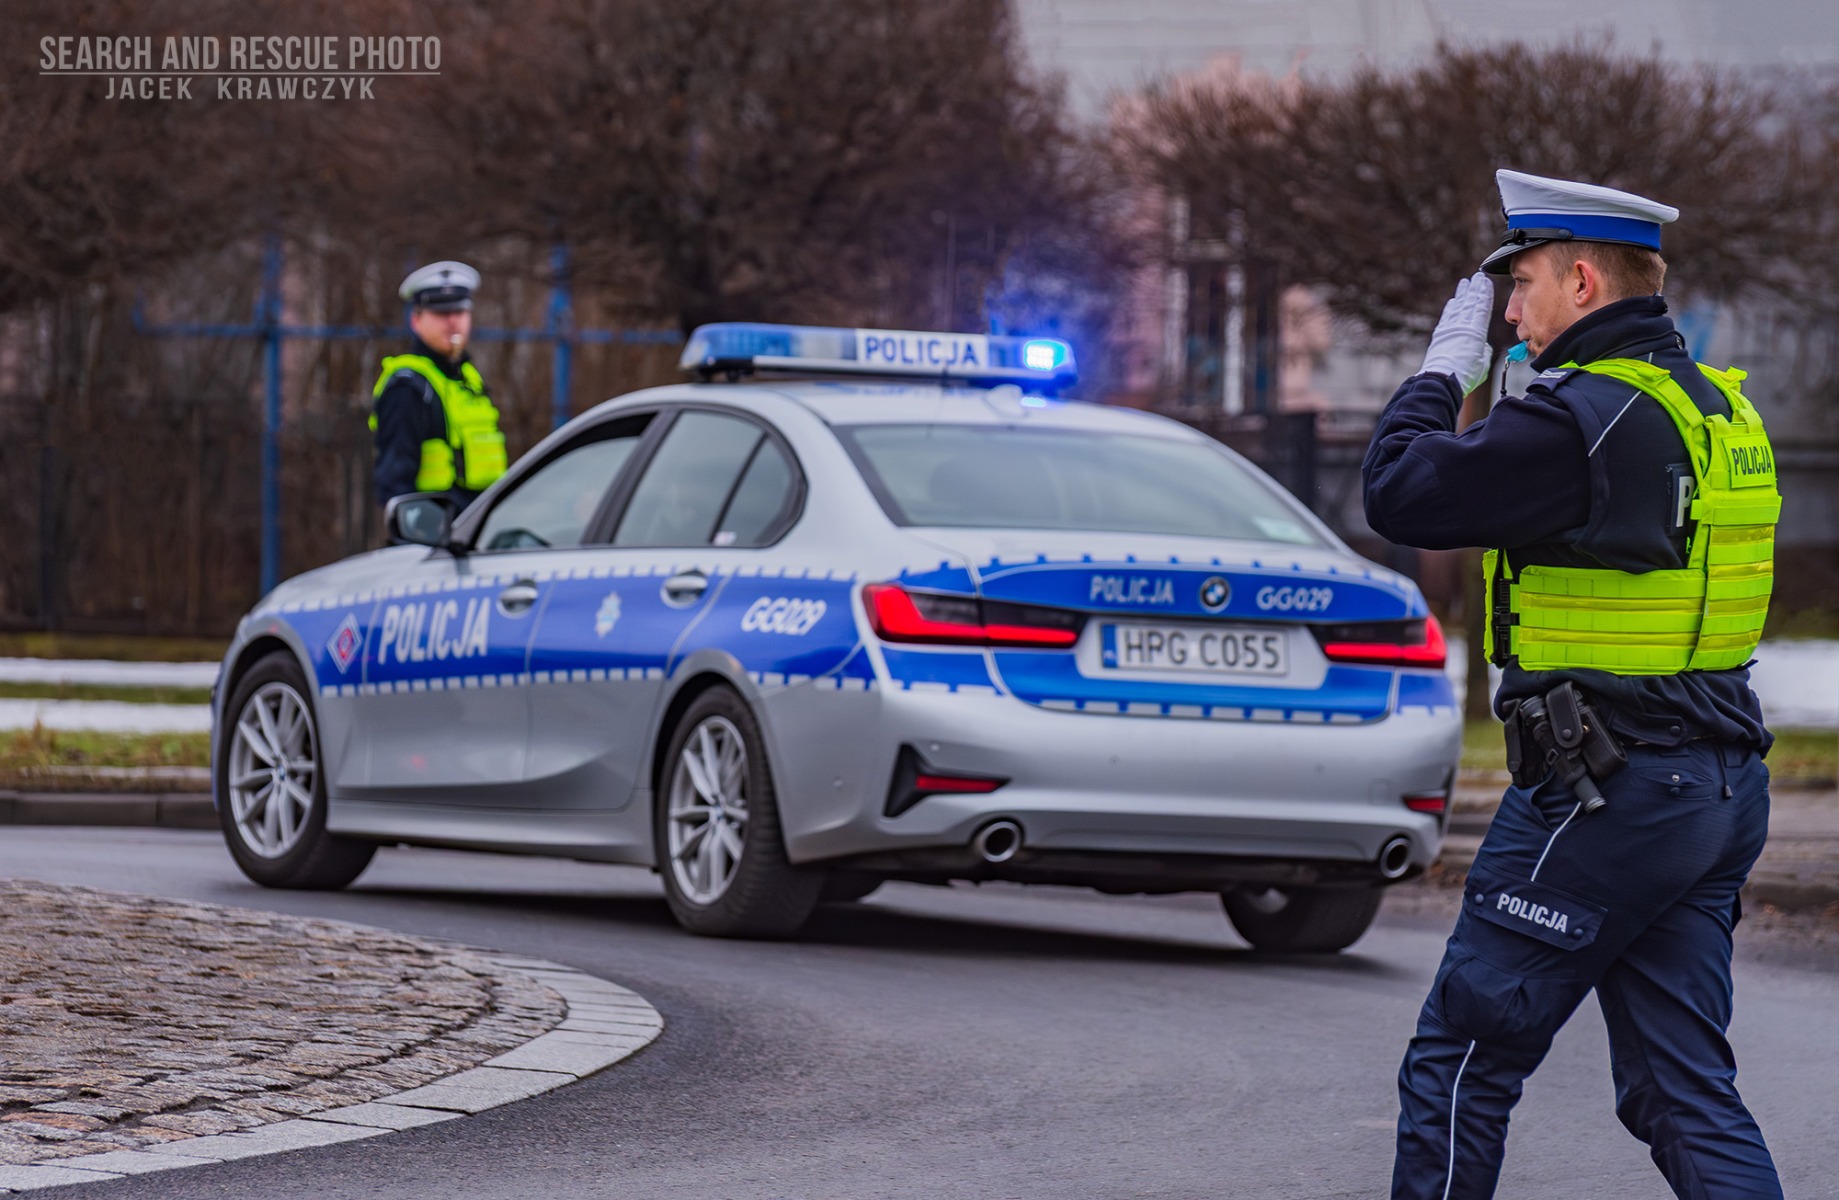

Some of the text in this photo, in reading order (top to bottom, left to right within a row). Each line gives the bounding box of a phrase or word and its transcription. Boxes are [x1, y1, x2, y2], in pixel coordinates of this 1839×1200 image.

[867, 337, 980, 366] POLICJA
[1731, 446, 1772, 475] POLICJA
[1090, 576, 1174, 603] POLICJA
[1257, 587, 1332, 611] GG029
[378, 598, 489, 664] POLICJA
[740, 596, 827, 636] GG029
[1125, 630, 1279, 669] HPG C055
[1497, 893, 1568, 932] POLICJA
